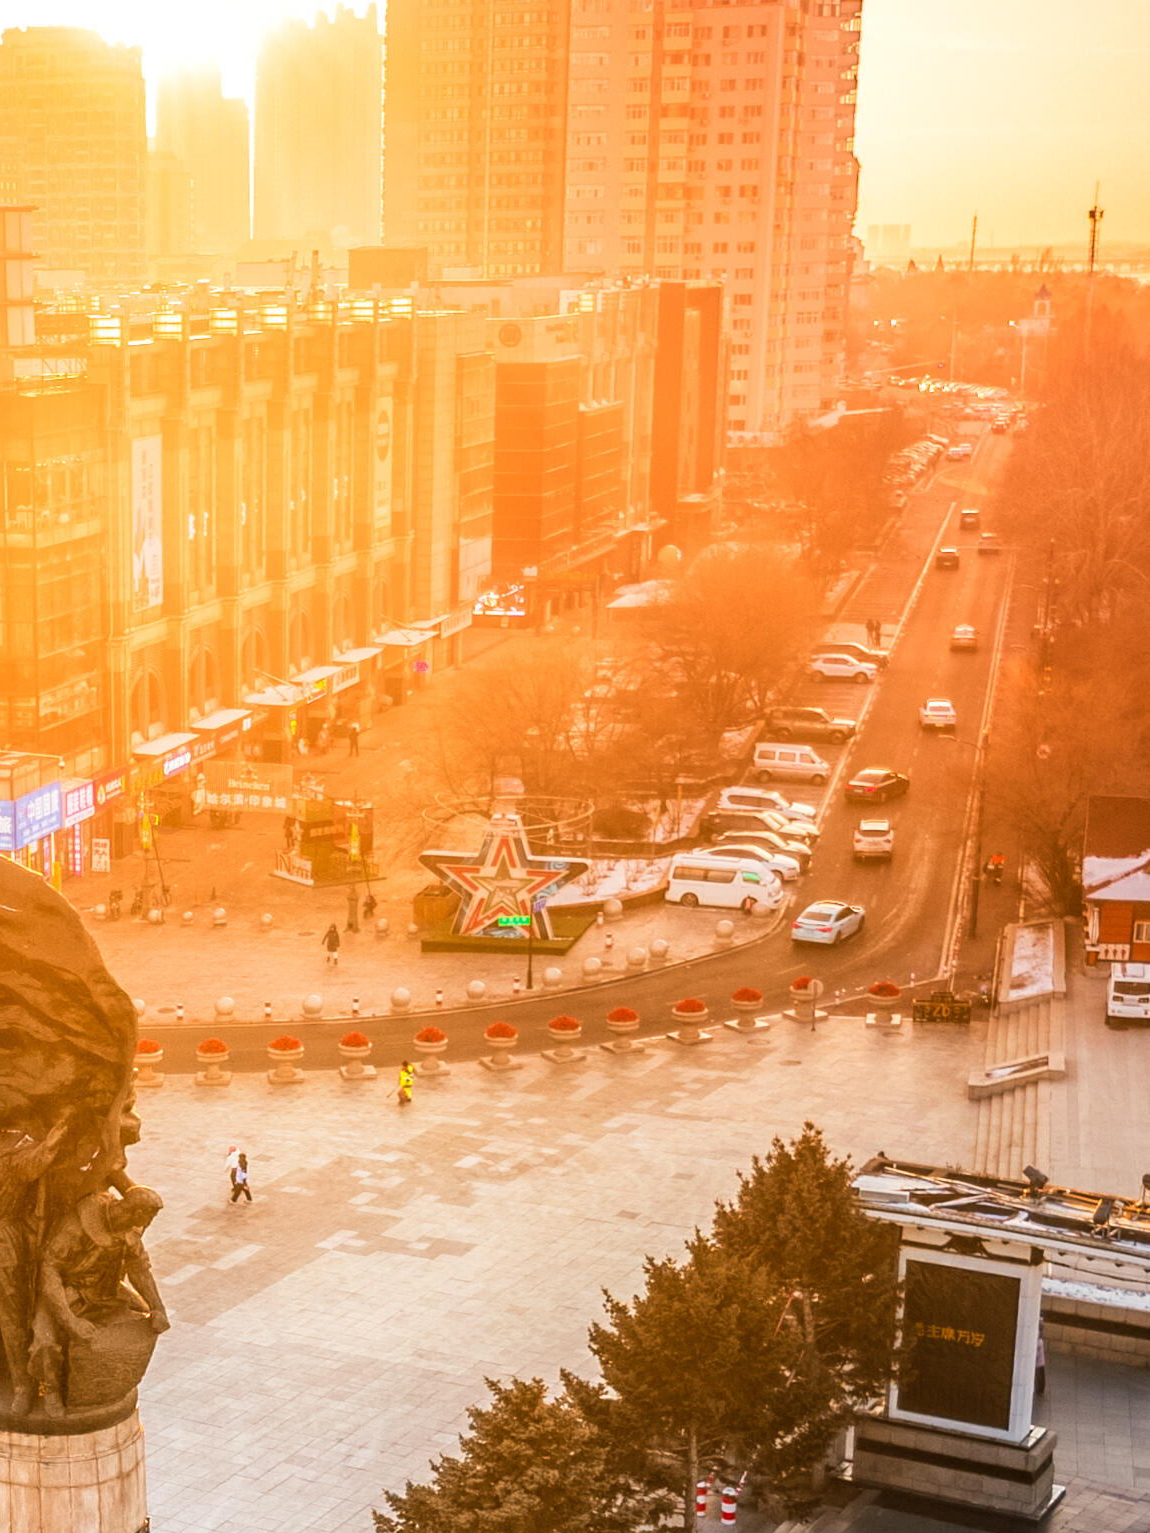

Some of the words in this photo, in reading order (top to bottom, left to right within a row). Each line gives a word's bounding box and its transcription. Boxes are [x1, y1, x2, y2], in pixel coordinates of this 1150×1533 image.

[227, 778, 271, 791] Heineken
[206, 792, 287, 809] 哈尔滨·印象城
